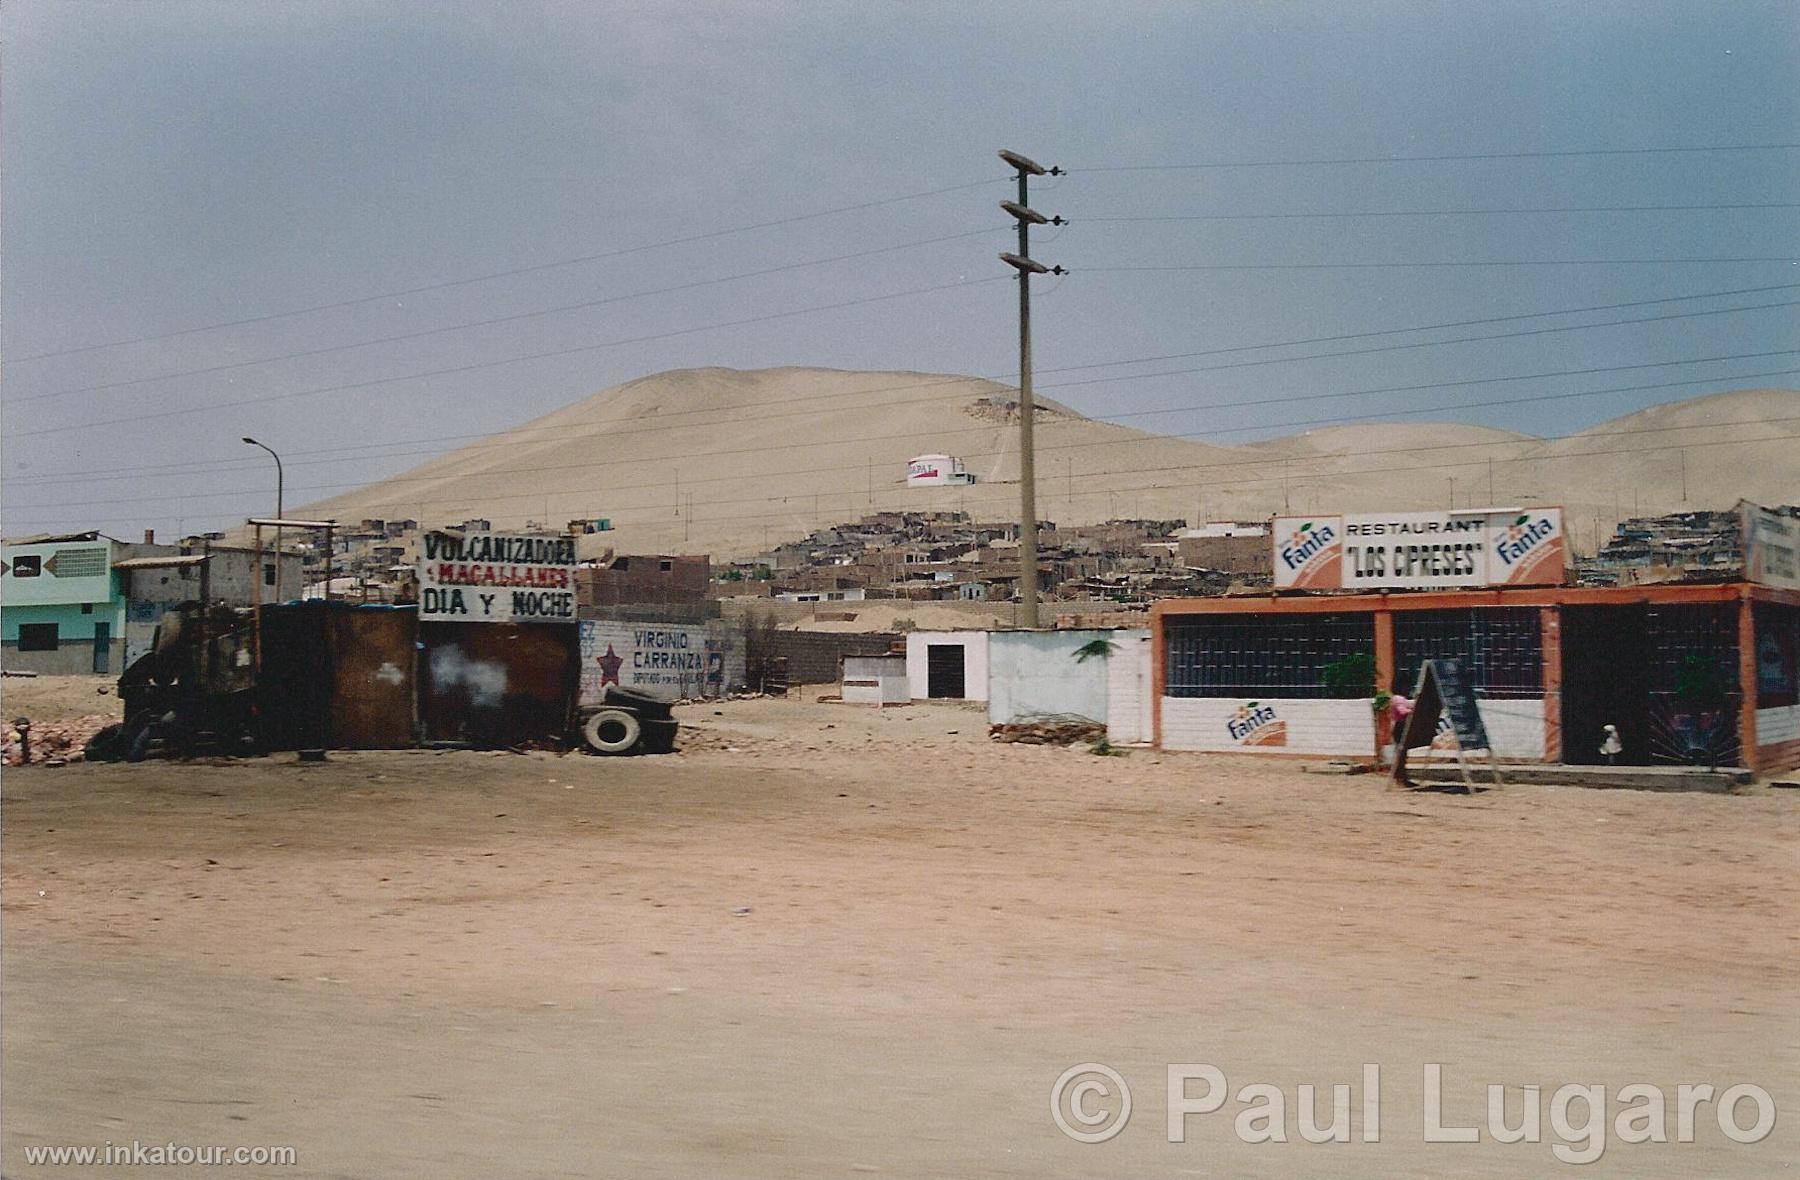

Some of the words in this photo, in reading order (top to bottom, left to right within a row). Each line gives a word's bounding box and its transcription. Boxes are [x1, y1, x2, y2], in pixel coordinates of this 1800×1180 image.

[1346, 520, 1485, 536] RESTAURANT
[1496, 518, 1553, 565] Fanta
[1282, 526, 1334, 570] Fanta
[424, 588, 467, 614] DIA
[480, 594, 495, 614] Y
[512, 591, 573, 617] NOCHE
[633, 631, 688, 649] VIRGINIO
[633, 652, 702, 670] CARRANZA
[1227, 707, 1276, 740] Fanta
